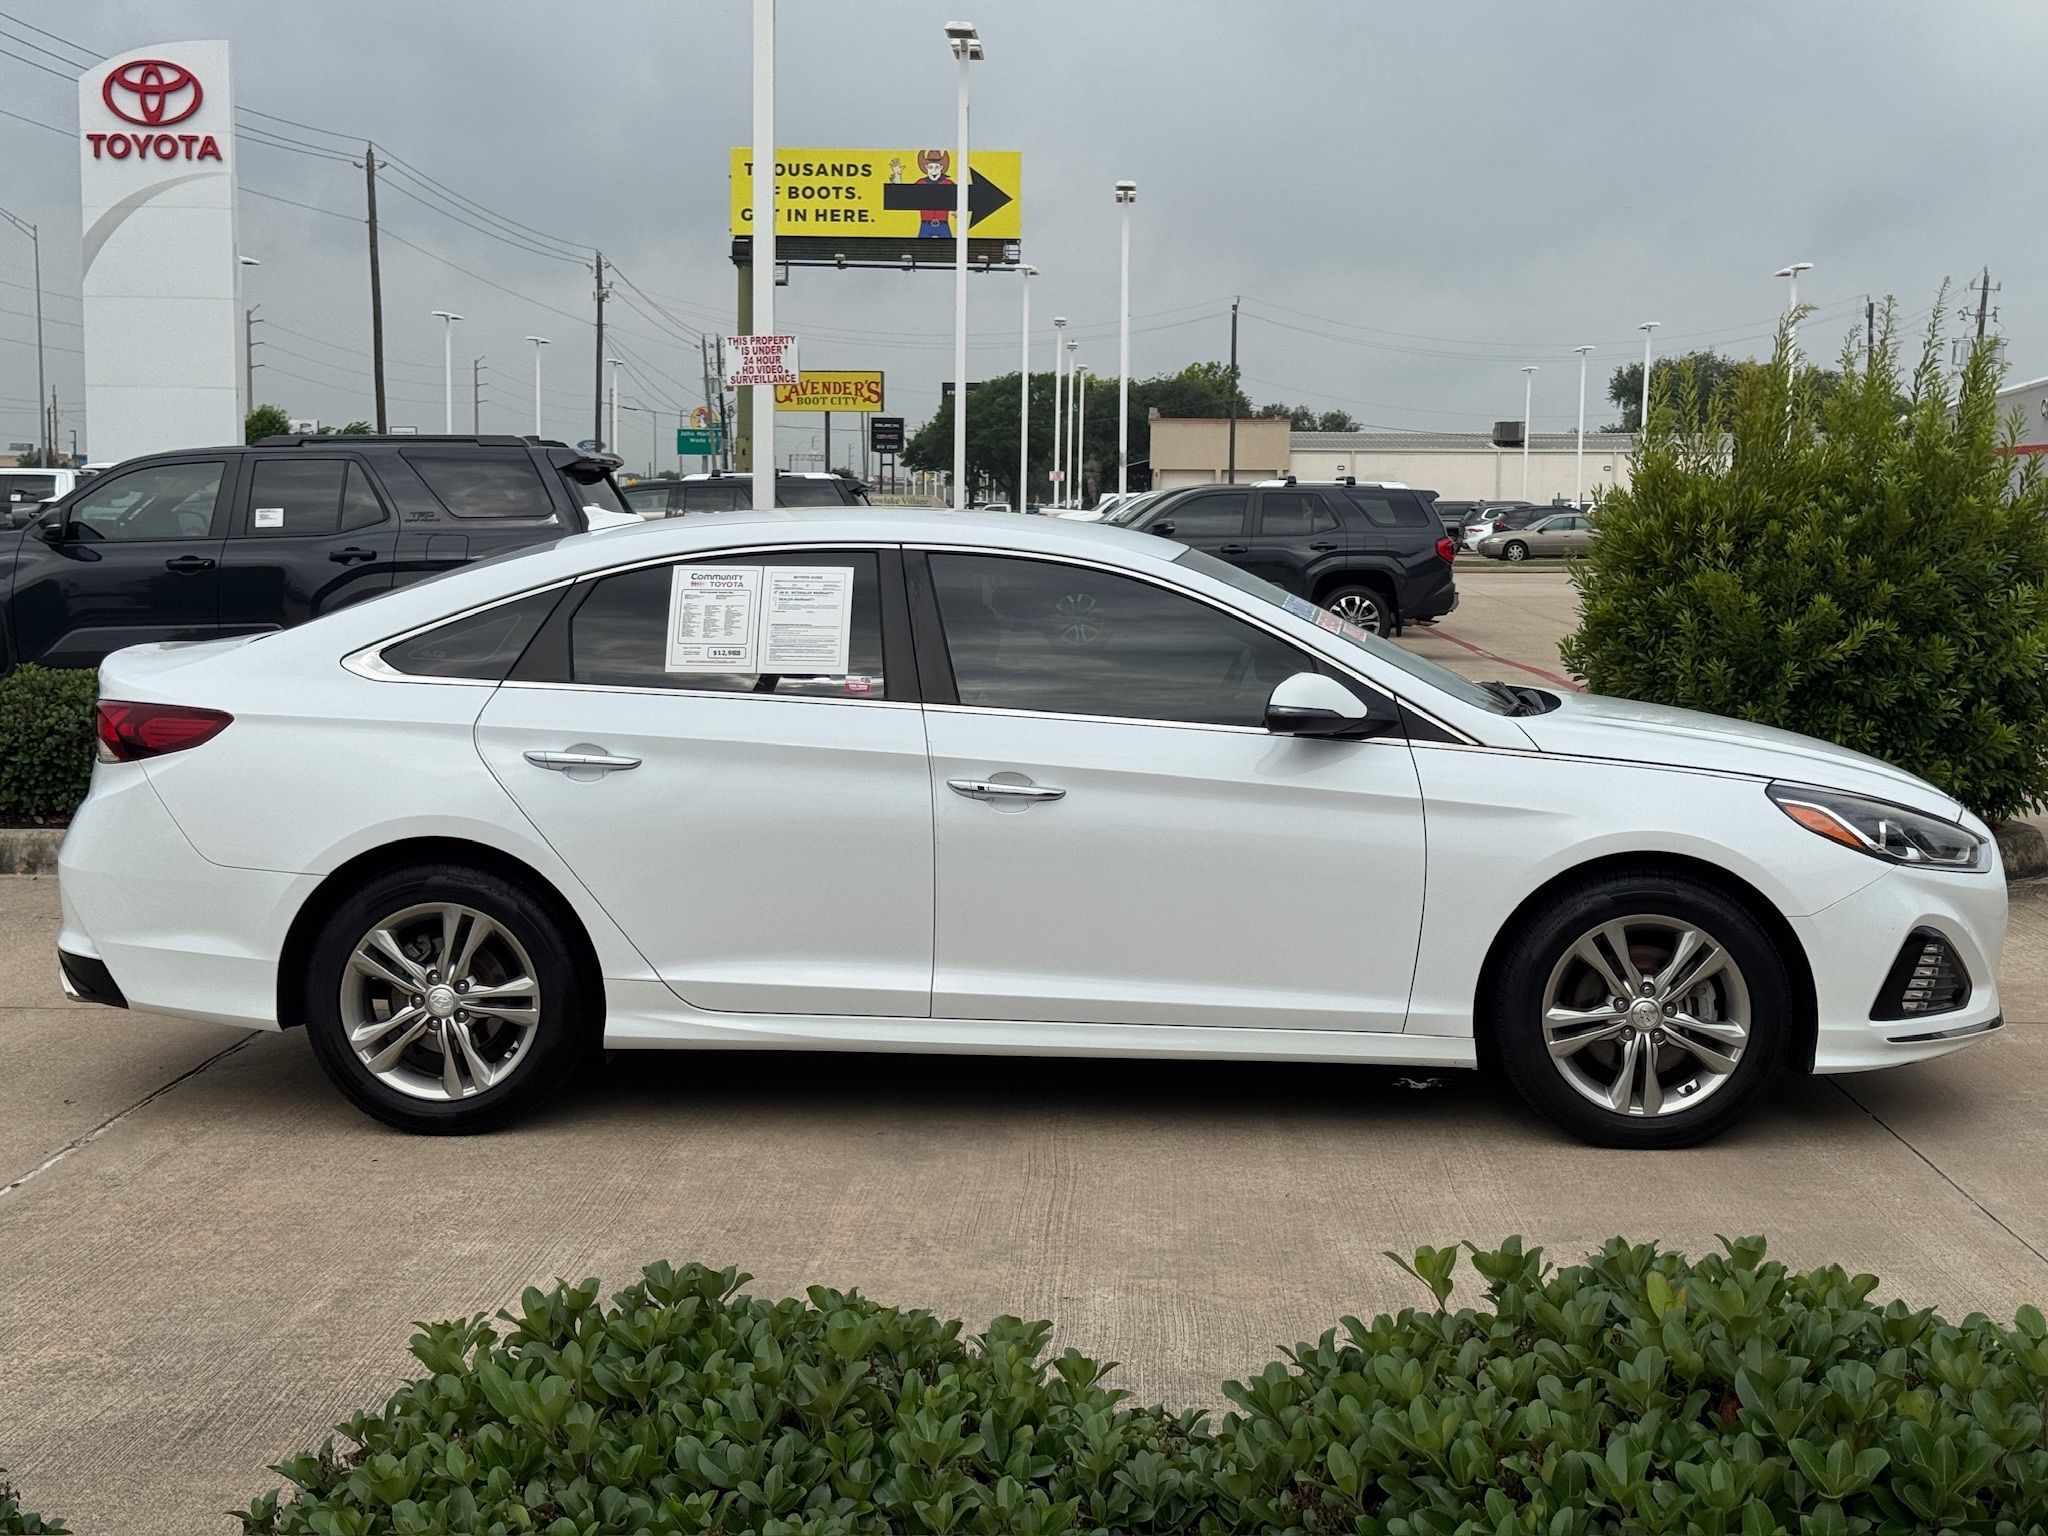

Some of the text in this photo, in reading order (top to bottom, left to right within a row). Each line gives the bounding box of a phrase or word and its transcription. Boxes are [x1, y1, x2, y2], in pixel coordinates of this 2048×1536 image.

[86, 133, 222, 161] TOYOTA
[744, 162, 872, 177] TOUSANDS
[788, 186, 862, 200] BOOTS.
[787, 208, 807, 222] IN
[815, 209, 875, 223] HERE.
[727, 335, 796, 346] THIS PROPERTY
[741, 345, 783, 355] IS UNDER
[743, 355, 781, 365] 24 HOUR
[742, 365, 784, 374] HD VIDEO
[730, 374, 797, 384] SURVEILLANCE
[774, 379, 882, 404] CAVENDER'S
[796, 396, 858, 405] BOOT CITY
